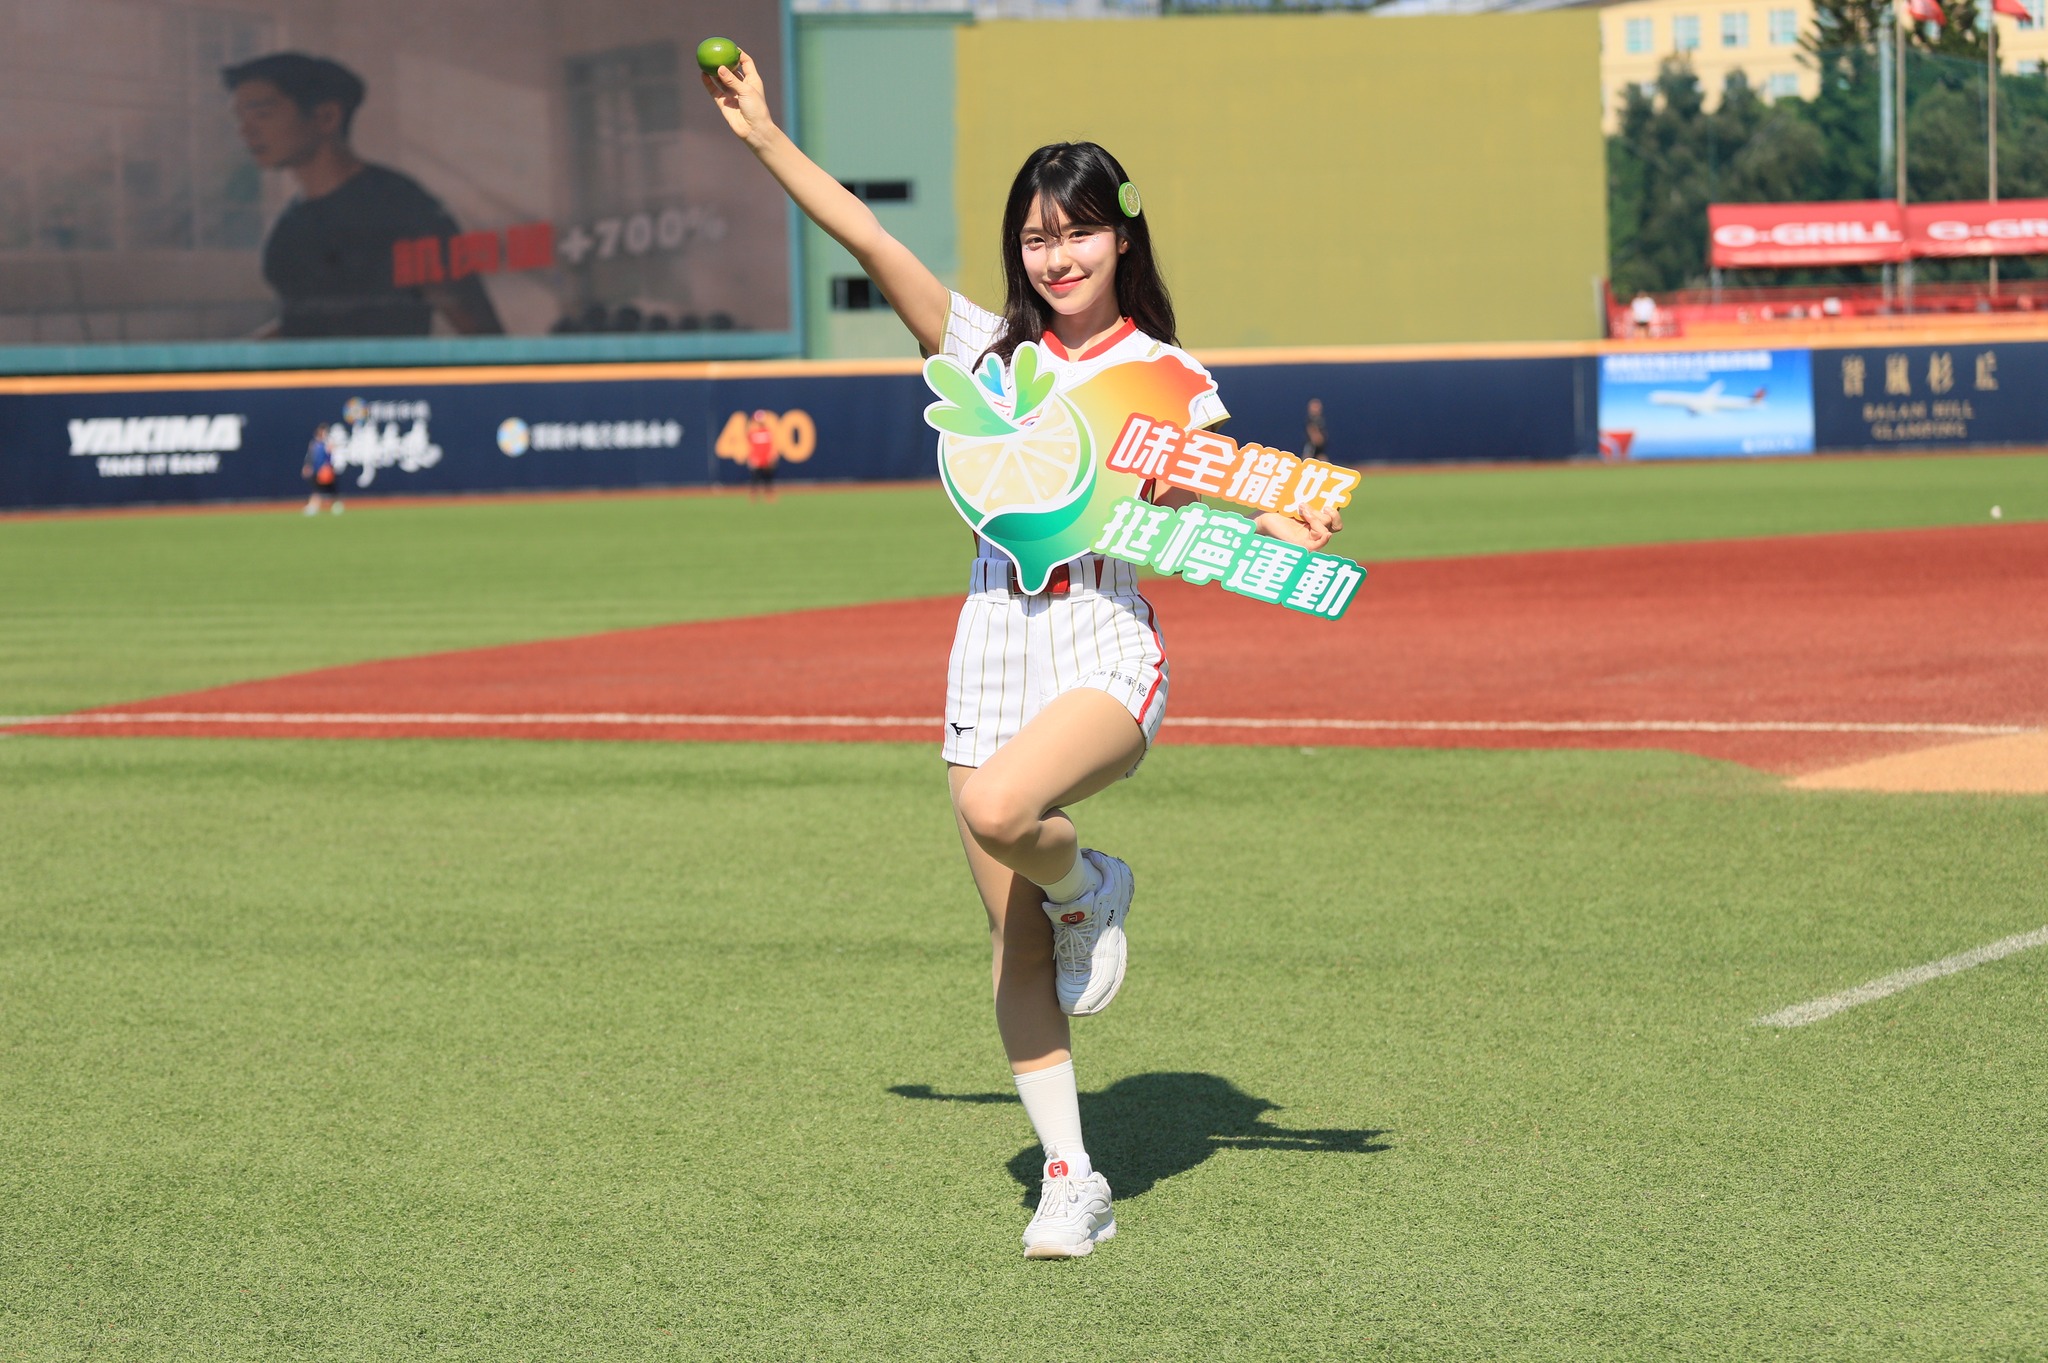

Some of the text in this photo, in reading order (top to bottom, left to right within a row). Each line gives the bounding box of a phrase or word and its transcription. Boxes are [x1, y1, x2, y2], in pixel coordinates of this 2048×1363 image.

[1714, 221, 1902, 247] O-GRILL
[68, 414, 242, 455] YAKIMA
[96, 452, 221, 477] TAKE IT EASY
[1111, 416, 1357, 513] 味全攏好
[1094, 500, 1363, 617] 挺檸運動
